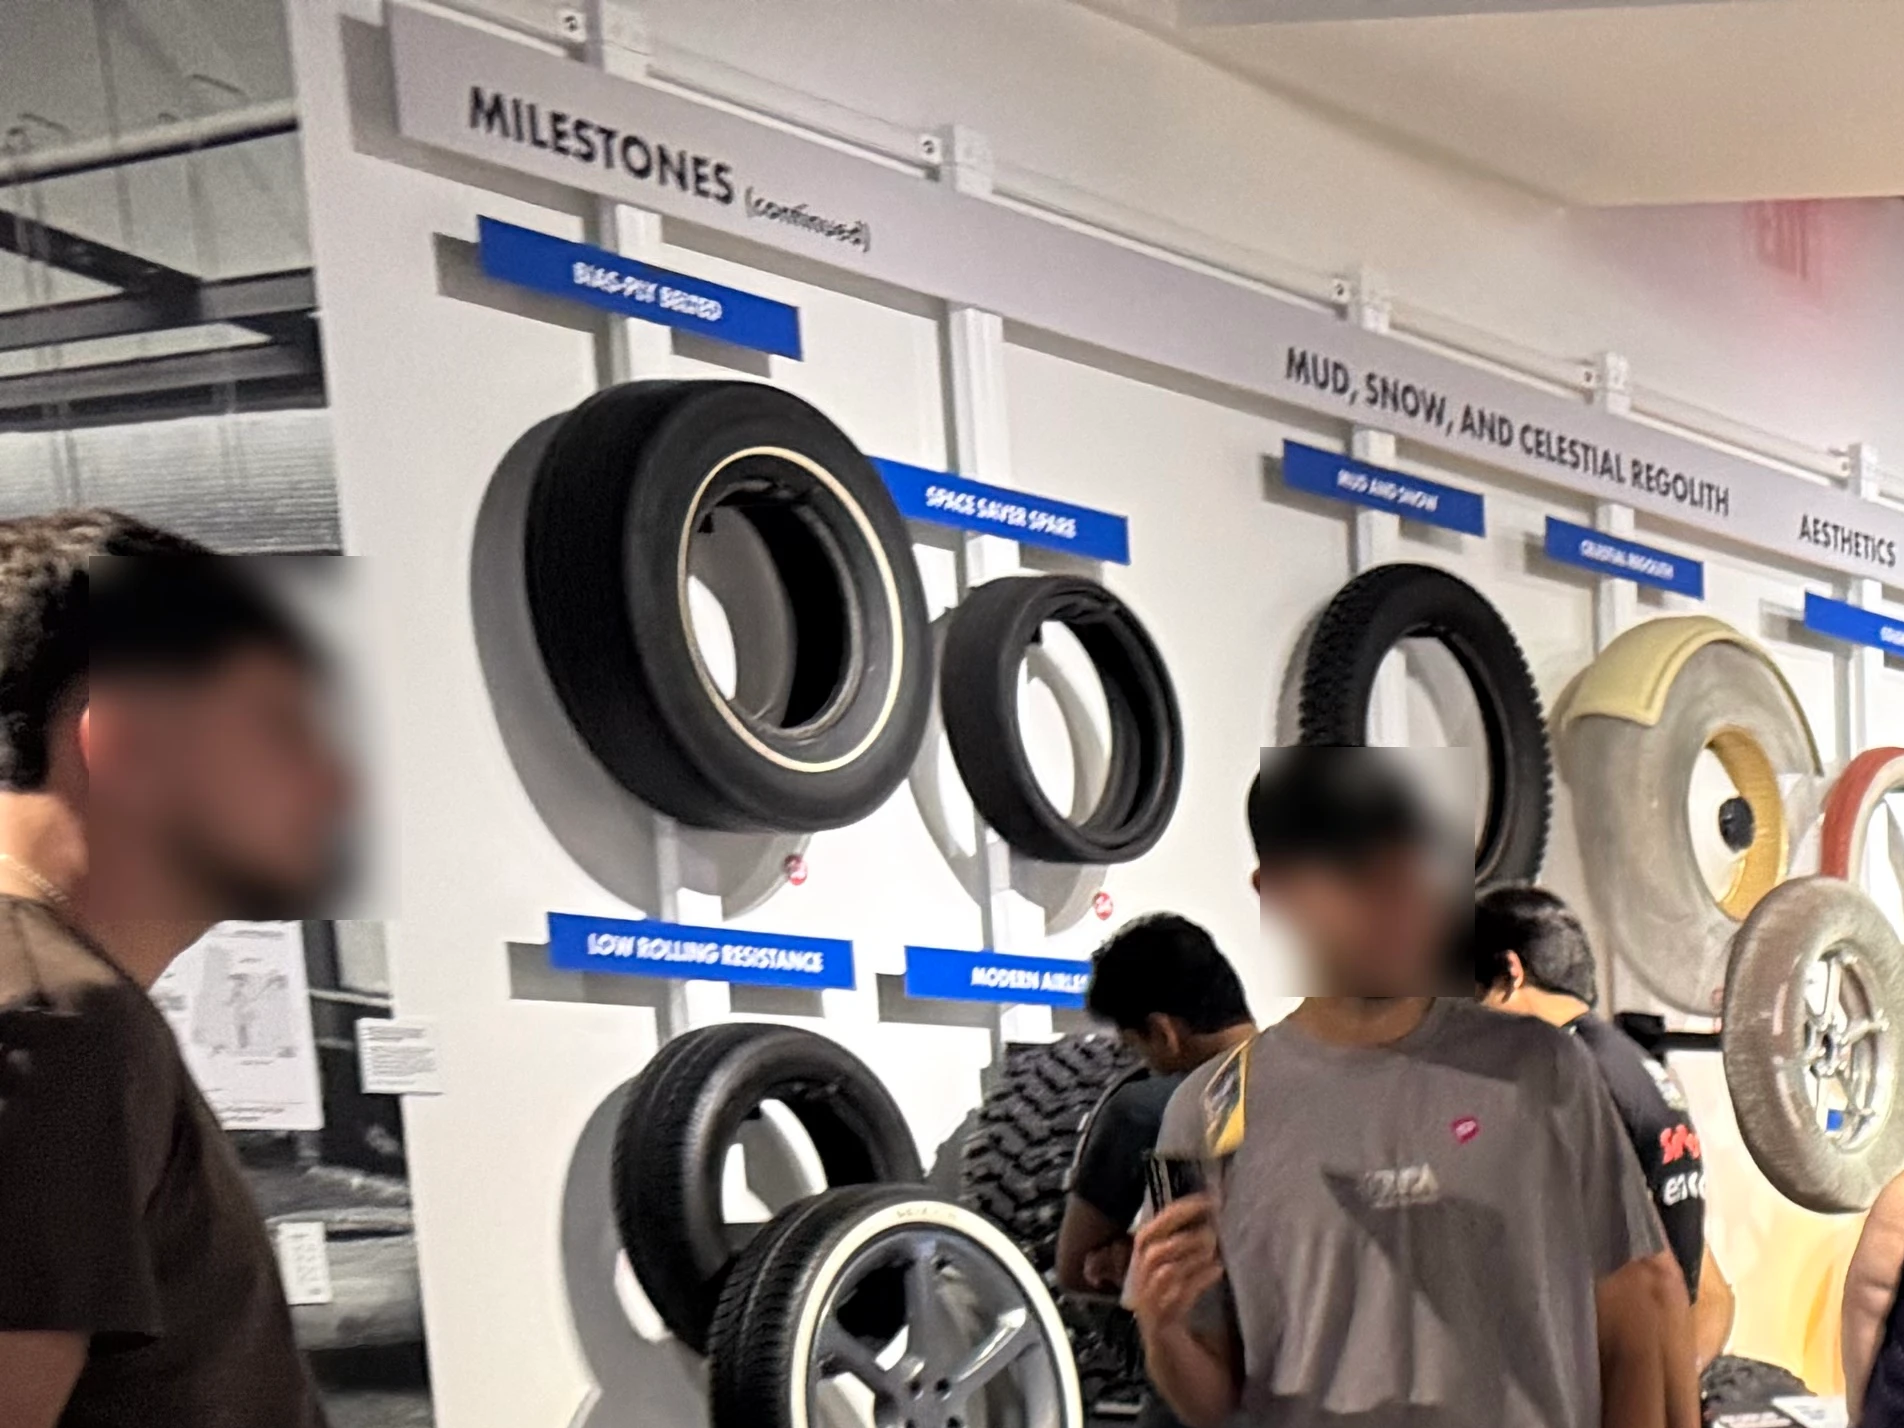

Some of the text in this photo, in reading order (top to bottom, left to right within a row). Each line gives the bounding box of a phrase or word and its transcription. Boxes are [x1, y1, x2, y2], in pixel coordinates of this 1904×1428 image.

[469, 86, 872, 253] MILESTONES (continued)
[1285, 346, 1730, 517] MUD, SNOW, AND CELESTIAL REGOLITH
[1798, 513, 1897, 568] AESTHETICS
[586, 932, 825, 973] LOW ROLLING RESISTANCE
[970, 966, 1039, 991] MODERN
